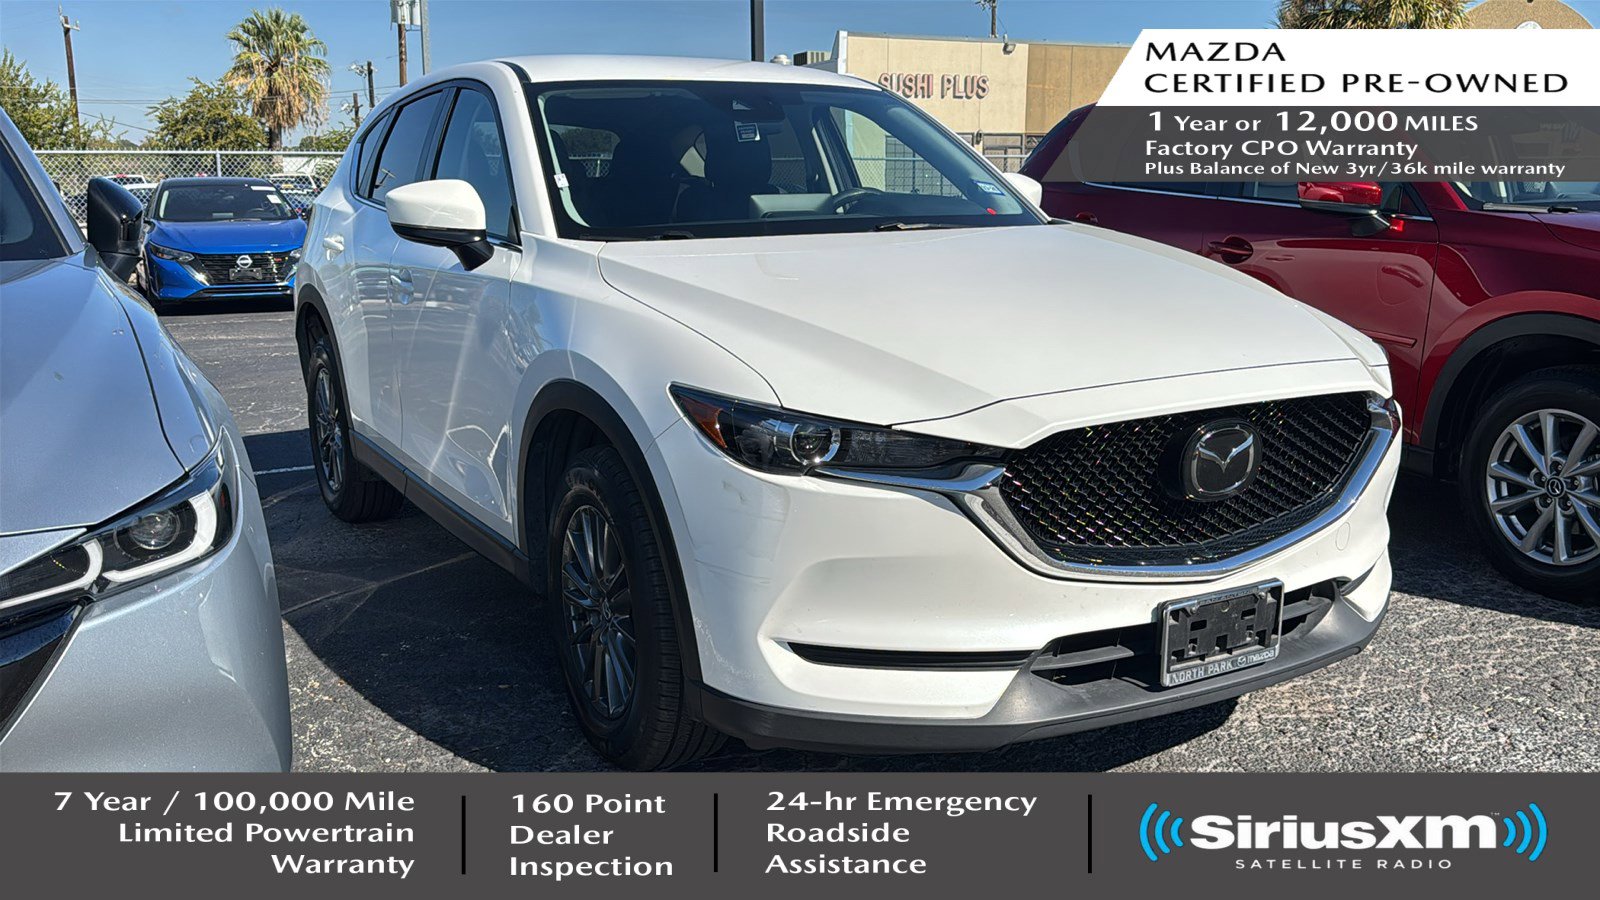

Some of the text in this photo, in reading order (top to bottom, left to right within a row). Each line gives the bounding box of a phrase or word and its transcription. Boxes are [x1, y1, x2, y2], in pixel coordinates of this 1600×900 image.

[879, 73, 990, 99] SUSHI PLUS
[1171, 667, 1205, 683] NORTH
[1207, 660, 1234, 675] PARK
